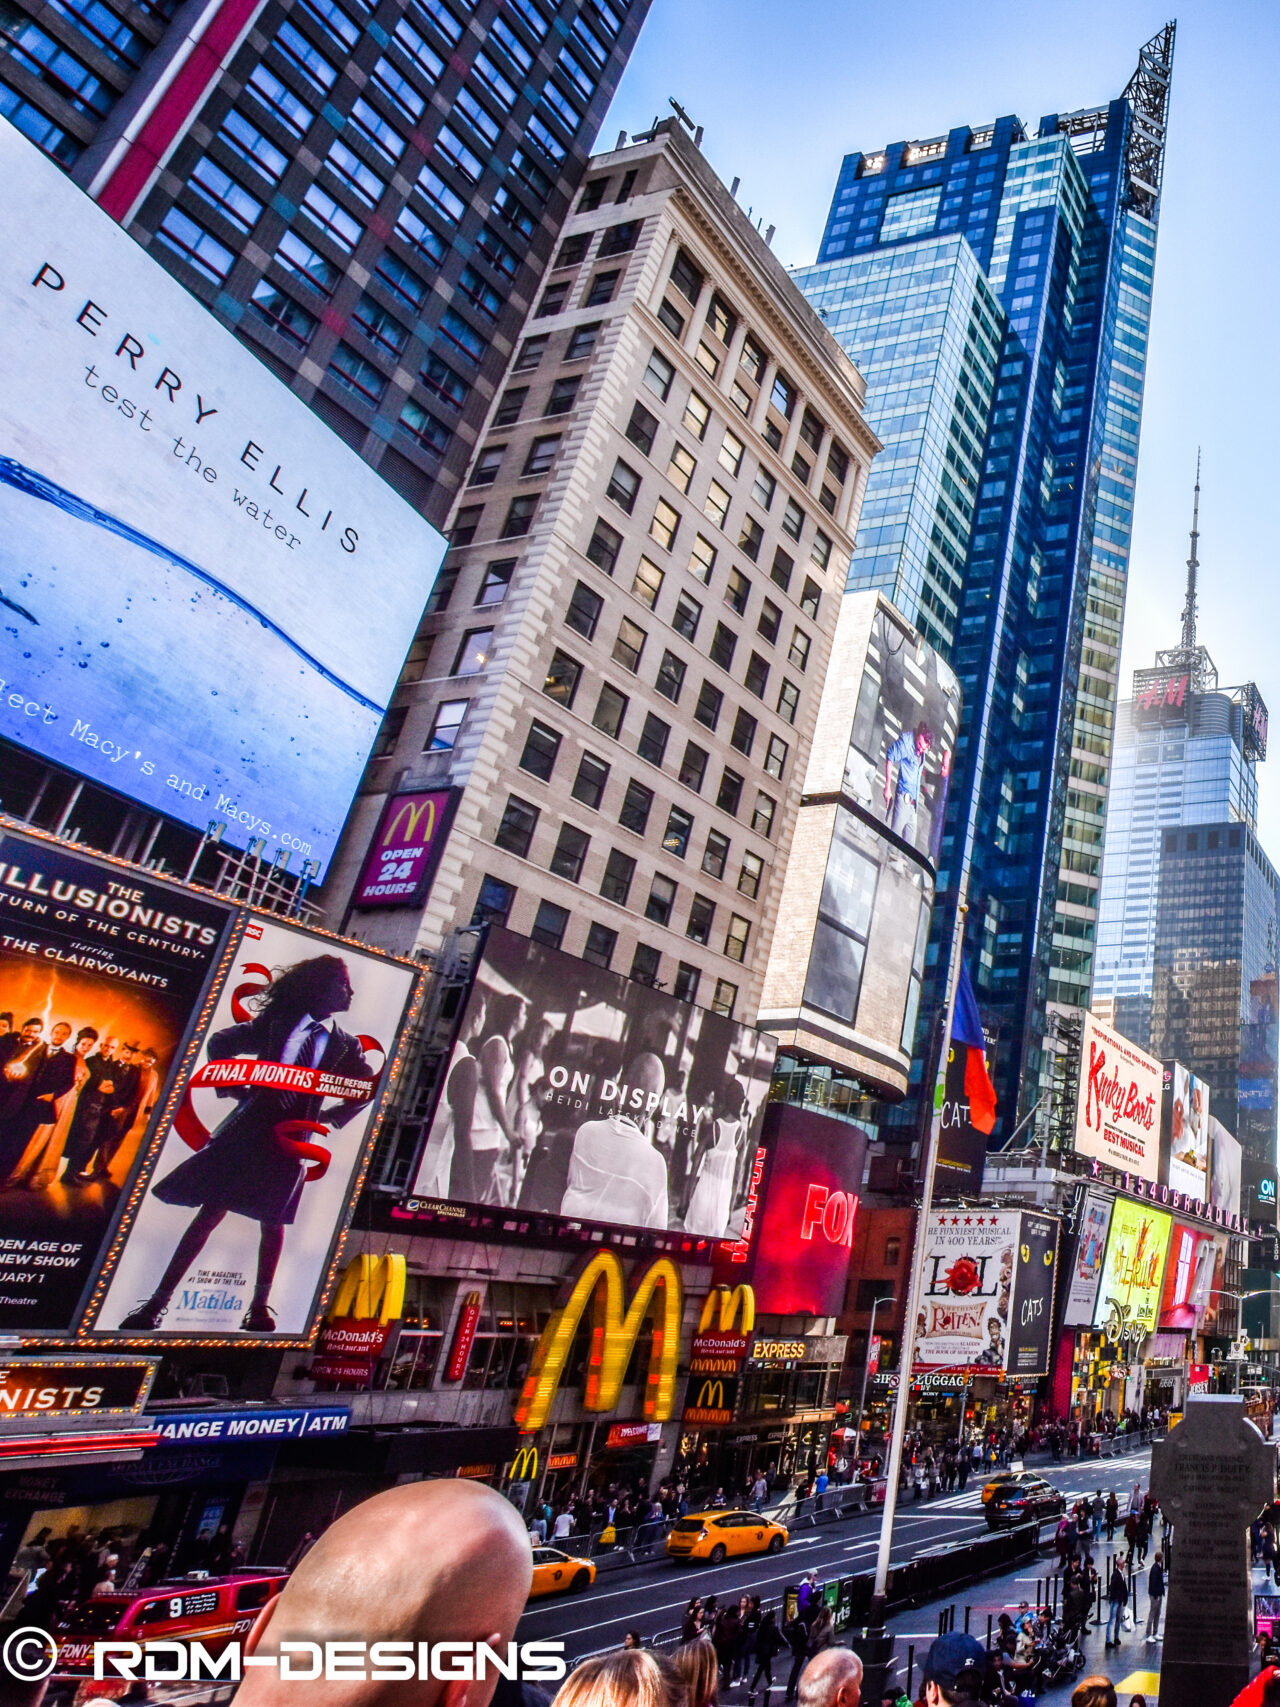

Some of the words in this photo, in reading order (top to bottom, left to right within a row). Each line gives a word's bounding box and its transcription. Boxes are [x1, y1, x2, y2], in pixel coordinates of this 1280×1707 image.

[31, 262, 218, 425] PERRY
[240, 440, 360, 554] ELLIS
[84, 363, 152, 432] test
[171, 434, 218, 484] the
[232, 487, 301, 551] water
[69, 718, 155, 776] Macy's
[166, 772, 206, 801] and
[215, 792, 313, 857] Macys.com
[380, 847, 424, 861] OPEN
[377, 861, 413, 882] 24
[108, 881, 145, 904] THE
[363, 882, 418, 898] HOURS
[55, 910, 80, 924] OF
[87, 918, 121, 936] THE
[69, 940, 115, 961] starring
[2, 935, 40, 954] THE
[44, 947, 169, 988] CLAIRVOYANTS
[201, 1064, 248, 1082] FINAL
[249, 1064, 315, 1089] MONTHS
[318, 1073, 334, 1083] SEE
[334, 1075, 344, 1085] IT
[344, 1078, 373, 1090] BEFORE
[1085, 1041, 1126, 1132] Kinky
[1123, 1080, 1157, 1131] Boots
[315, 1083, 364, 1099] JANUARY
[549, 1066, 591, 1095] ON
[600, 1079, 705, 1124] DISPLAY
[545, 1092, 589, 1111] HEIDI
[940, 1101, 972, 1129] CAT
[1103, 1128, 1121, 1147] BEST
[1120, 1134, 1145, 1158] MUSICAL
[1260, 1179, 1275, 1196] ON
[801, 1183, 859, 1248] FOX
[1172, 1188, 1249, 1233] BROADWAY
[935, 1236, 946, 1245] IN
[939, 1226, 976, 1236] FUNNIEST
[978, 1226, 1012, 1236] MUSICAL
[26, 1241, 60, 1252] AGE
[61, 1243, 83, 1254] OF
[33, 1255, 80, 1268] SHOW
[38, 1274, 45, 1283] 1
[176, 1290, 243, 1310] Matilda
[1021, 1297, 1044, 1326] CATS
[321, 1329, 384, 1343] McDonald's
[693, 1338, 747, 1349] McDonald's
[327, 1343, 369, 1352] Restaurant
[753, 1342, 806, 1359] EXPRESS
[312, 1367, 332, 1375] OPEN
[343, 1367, 369, 1376] HOURS
[915, 1375, 974, 1387] LUGGAGE
[227, 1418, 300, 1437] MONEY
[307, 1415, 348, 1432] ATM
[169, 1597, 183, 1618] 9
[60, 1644, 91, 1658] FDNY
